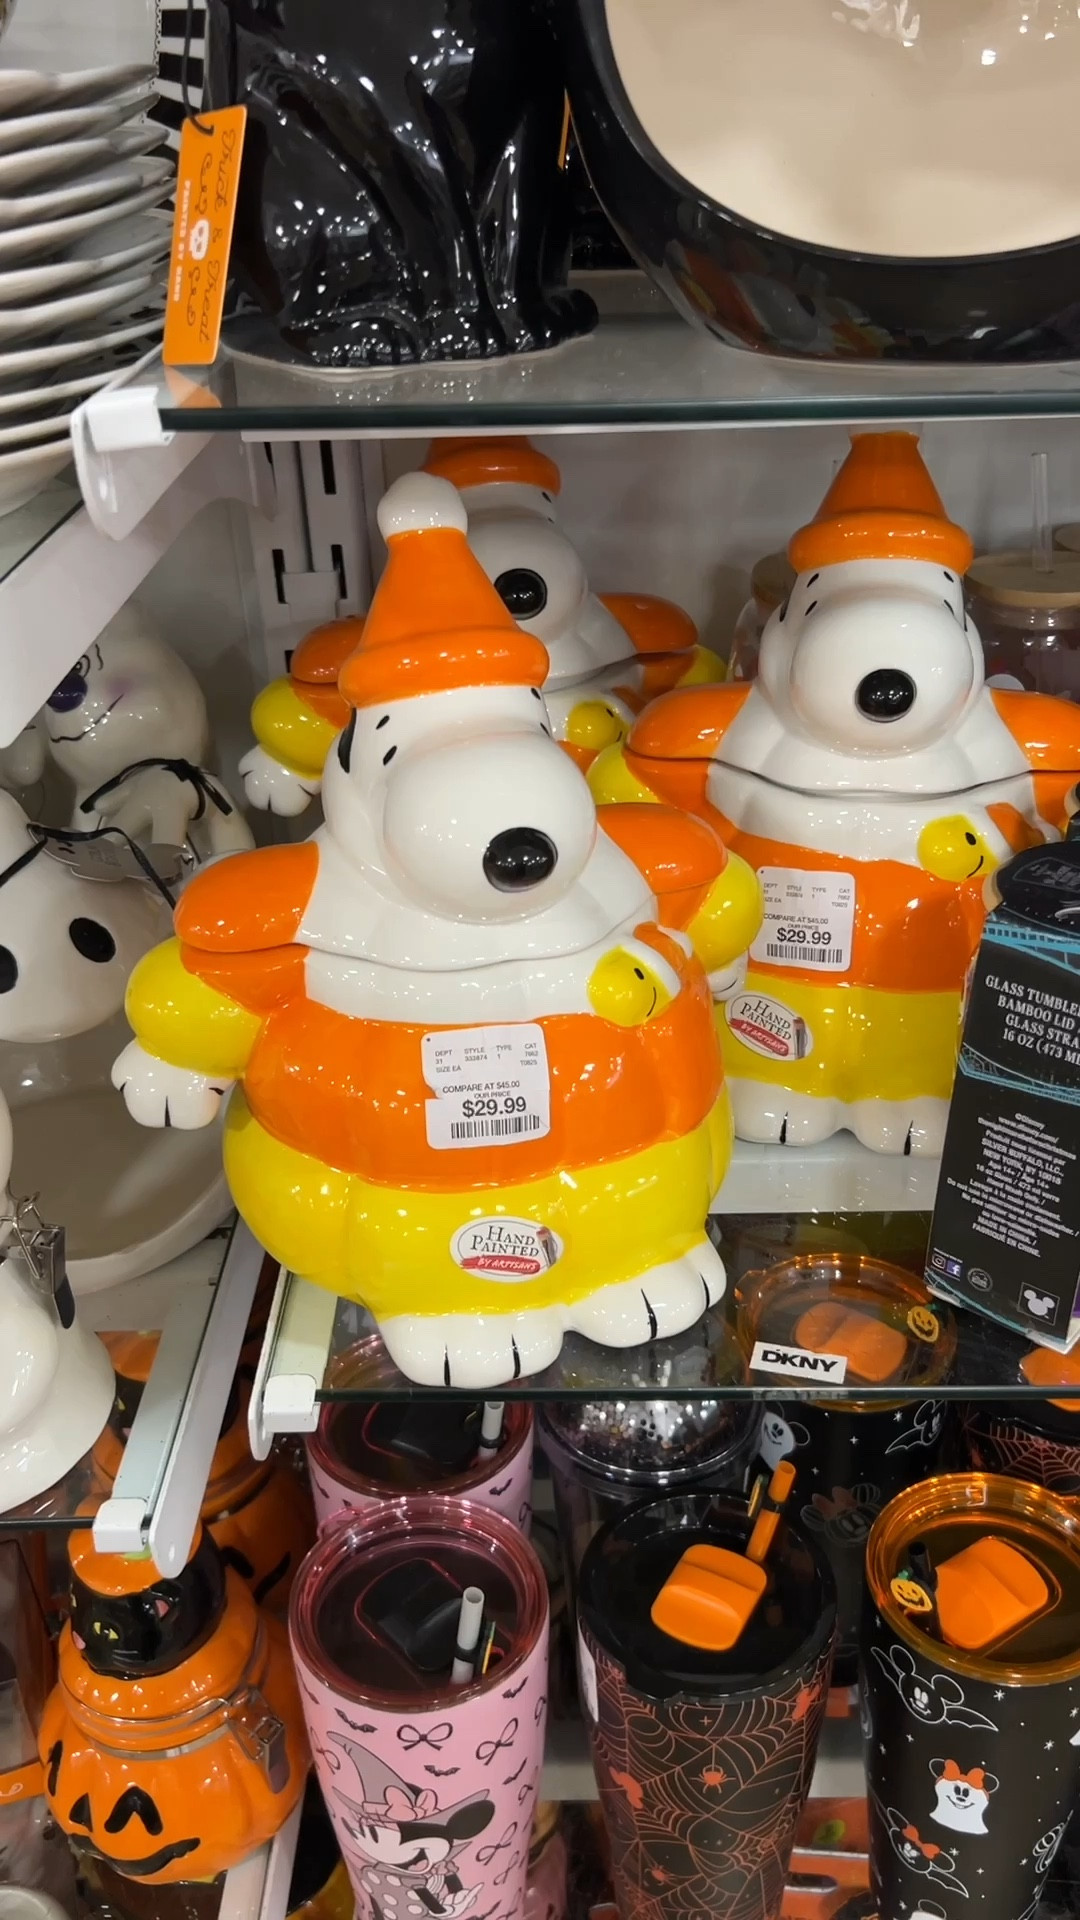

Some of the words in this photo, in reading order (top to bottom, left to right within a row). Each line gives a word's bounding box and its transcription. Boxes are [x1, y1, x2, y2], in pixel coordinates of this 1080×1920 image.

[217, 129, 235, 212] Trick
[212, 227, 222, 243] &
[178, 243, 185, 260] BY
[200, 260, 220, 343] Treat
[763, 913, 796, 923] COMPARE
[776, 927, 832, 946] $29.99
[985, 975, 1025, 997] GLASS
[740, 1003, 791, 1040] PAINTED
[756, 1000, 791, 1029] HAND
[997, 995, 1052, 1022] BAMBOO
[1054, 1014, 1076, 1030] LID
[1005, 1014, 1044, 1036] GLASS
[435, 1049, 453, 1057] DEPT
[1003, 1028, 1015, 1041] 16
[1017, 1034, 1034, 1048] OZ
[1036, 1038, 1063, 1058] (473
[442, 1083, 482, 1094] COMPARE
[496, 1080, 520, 1089] $45.00
[462, 1096, 527, 1119] $29.99
[470, 1235, 539, 1257] PAINTED
[487, 1225, 535, 1246] HAND
[477, 1258, 490, 1267] BY
[491, 1260, 537, 1270] ARTISANS
[761, 1350, 838, 1372] DKNY
